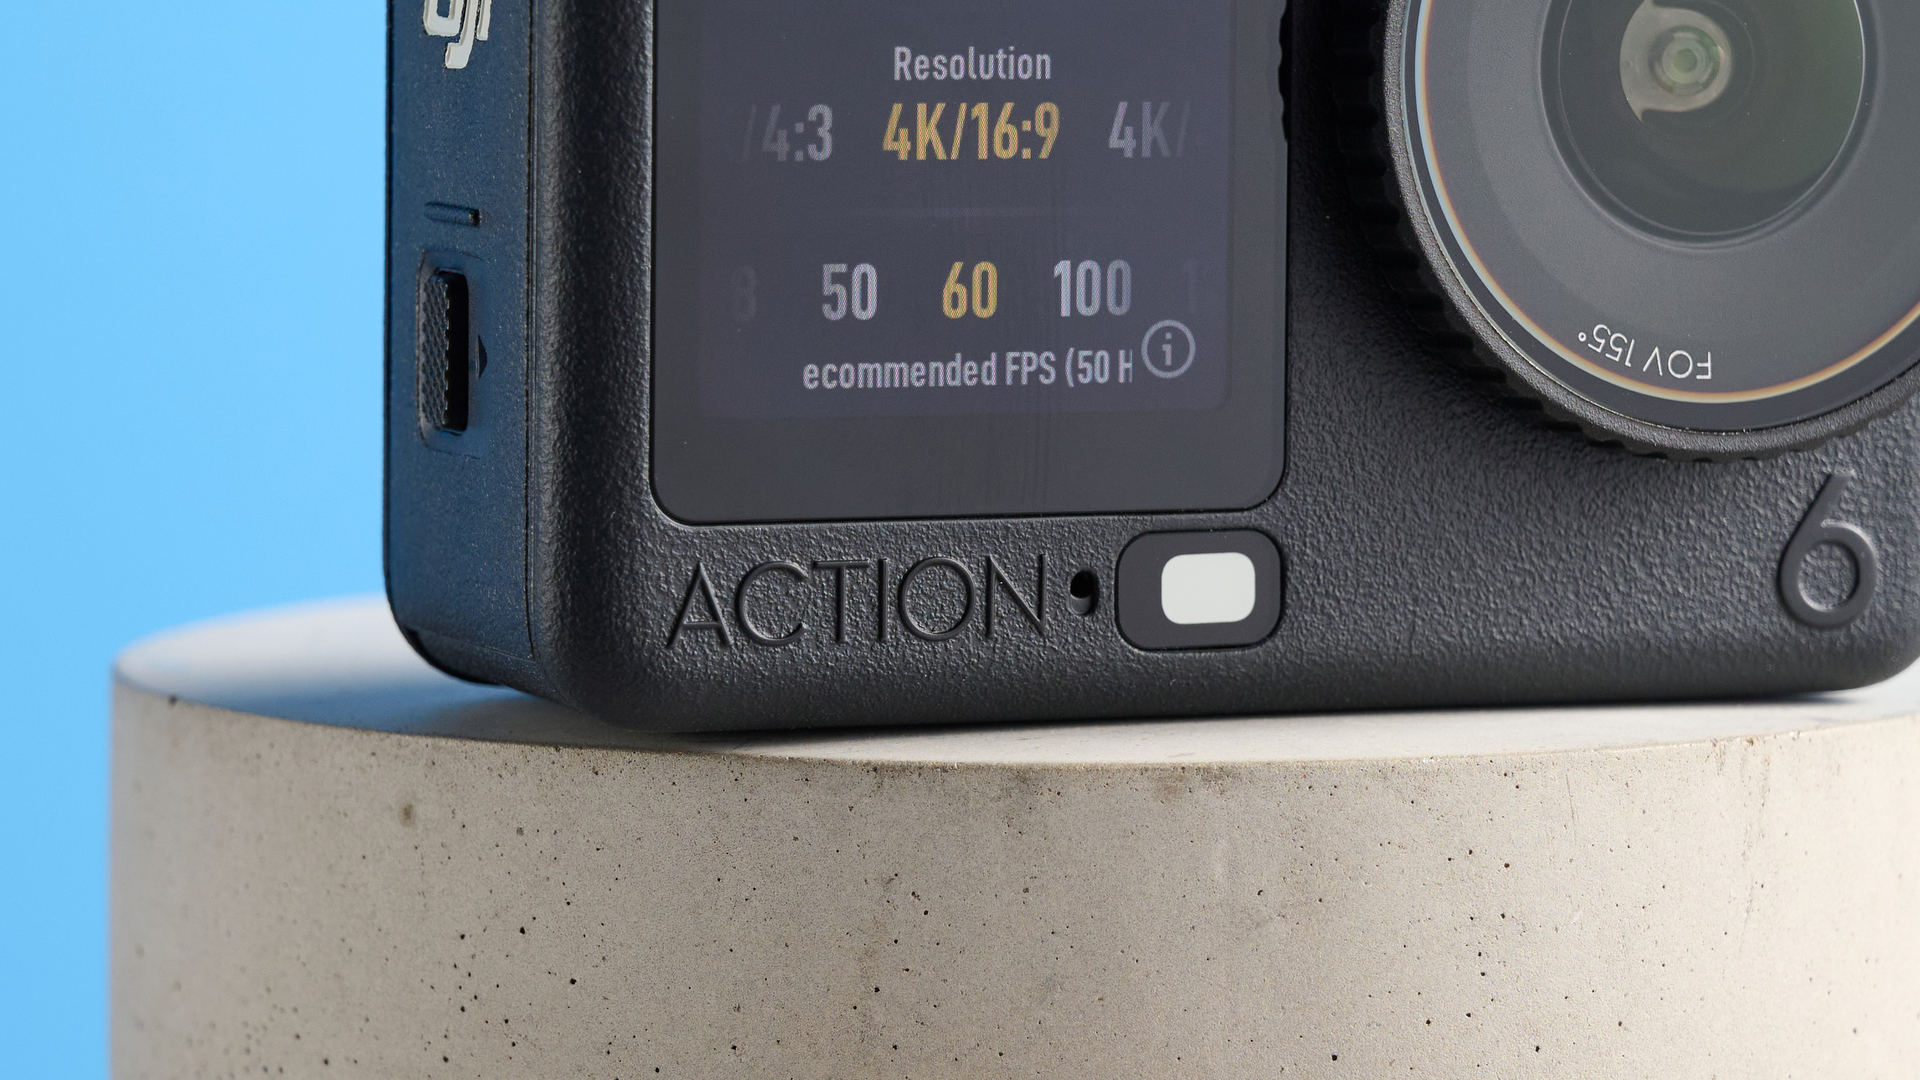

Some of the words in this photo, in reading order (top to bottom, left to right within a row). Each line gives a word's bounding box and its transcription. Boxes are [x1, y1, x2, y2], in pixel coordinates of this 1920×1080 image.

[894, 46, 1051, 81] Resolution
[882, 102, 1060, 161] 4K/16:9
[822, 263, 878, 321] 50
[942, 261, 998, 319] 60
[1053, 259, 1131, 317] 100
[803, 352, 997, 390] ecommended
[1005, 349, 1056, 387] FPS
[1065, 347, 1110, 388] (50
[1578, 324, 1635, 368] 155°
[1643, 346, 1712, 380] FOV
[1776, 466, 1879, 630] 6
[666, 553, 1048, 648] ACTION
